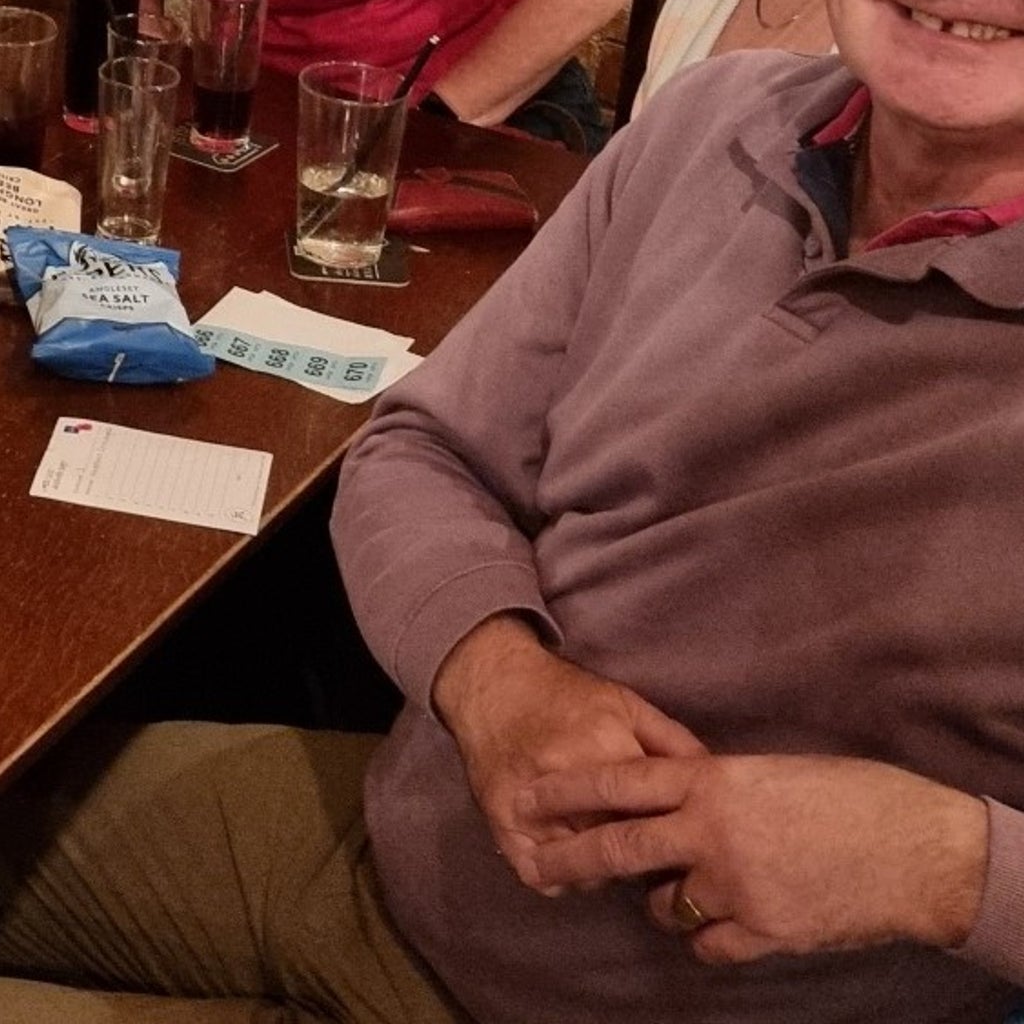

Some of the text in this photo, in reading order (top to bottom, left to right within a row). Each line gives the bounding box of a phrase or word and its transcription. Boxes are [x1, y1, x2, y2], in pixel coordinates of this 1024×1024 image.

[113, 294, 151, 304] SALT
[227, 336, 251, 358] 667
[265, 348, 290, 369] 668
[304, 356, 329, 378] 669
[344, 361, 369, 382] 670
